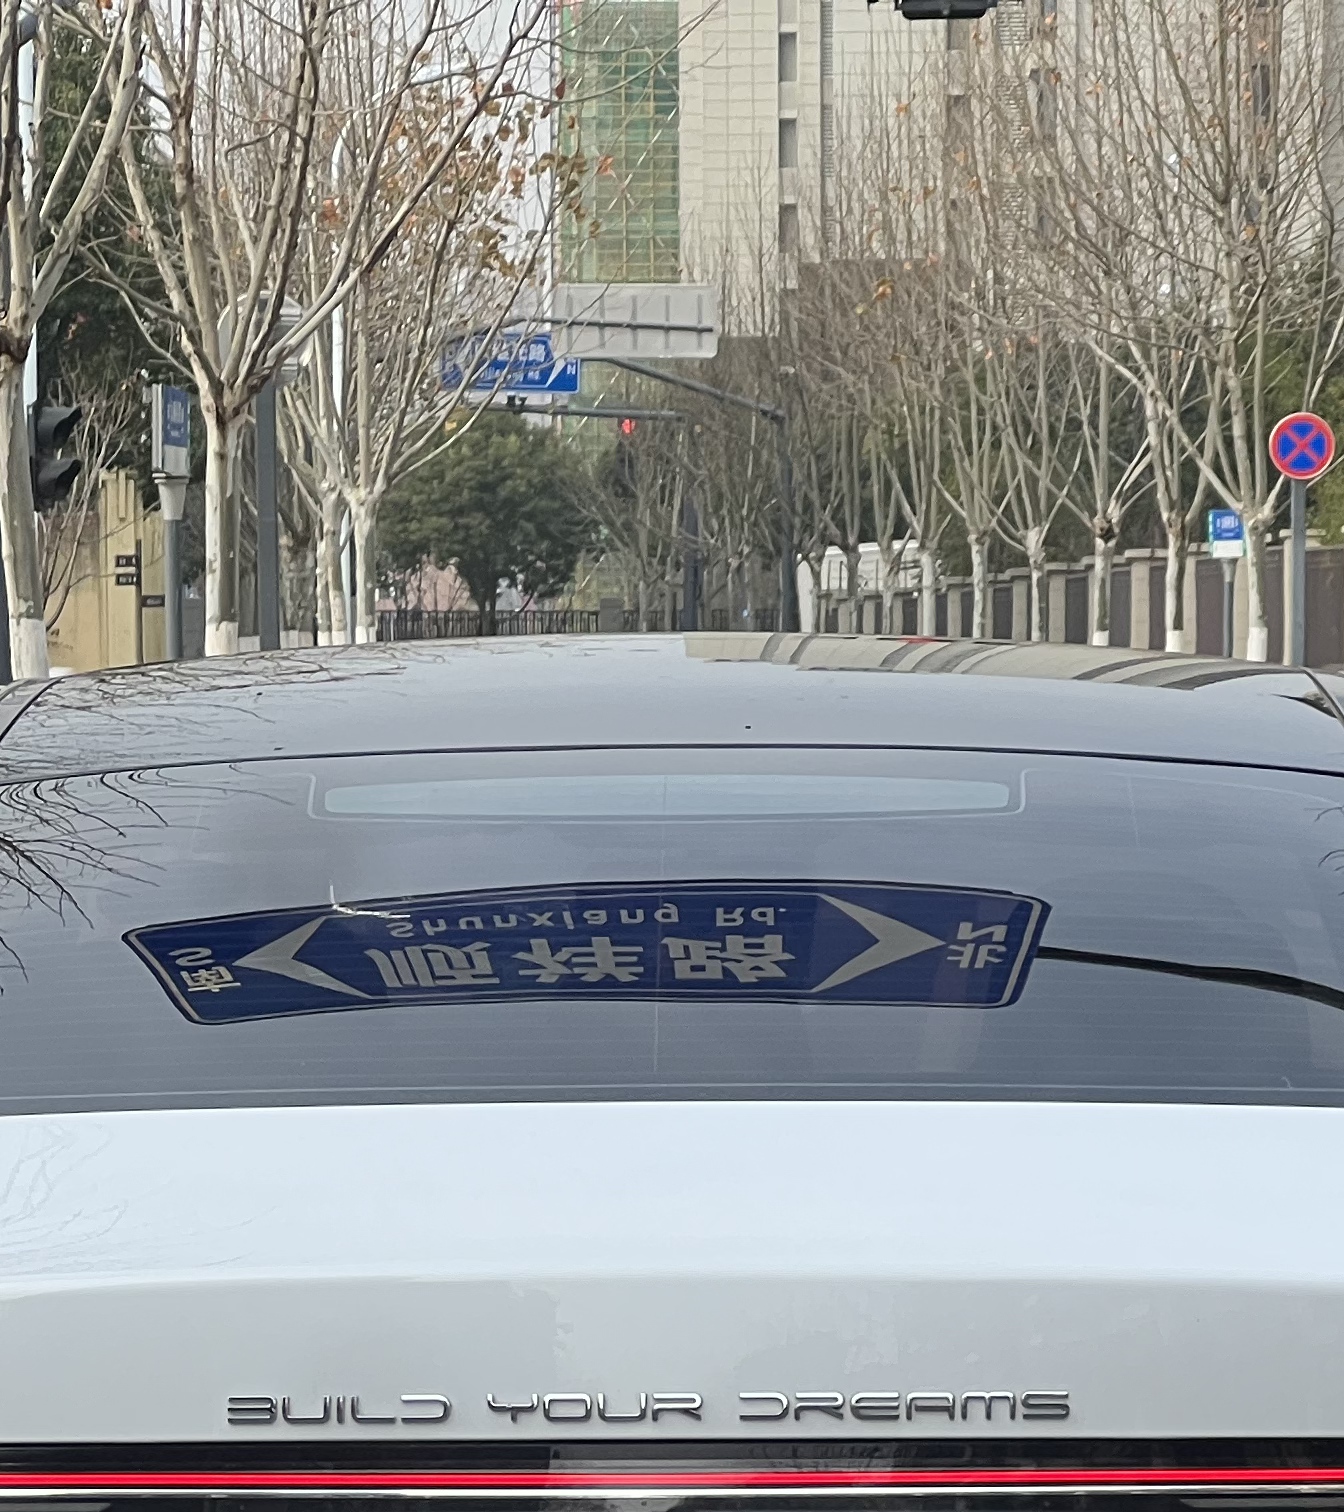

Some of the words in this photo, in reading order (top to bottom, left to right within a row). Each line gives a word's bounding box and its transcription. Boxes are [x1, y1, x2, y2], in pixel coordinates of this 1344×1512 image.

[228, 1393, 452, 1424] BUILD
[487, 1392, 702, 1424] YOUR
[739, 1390, 1070, 1421] DREAMS
